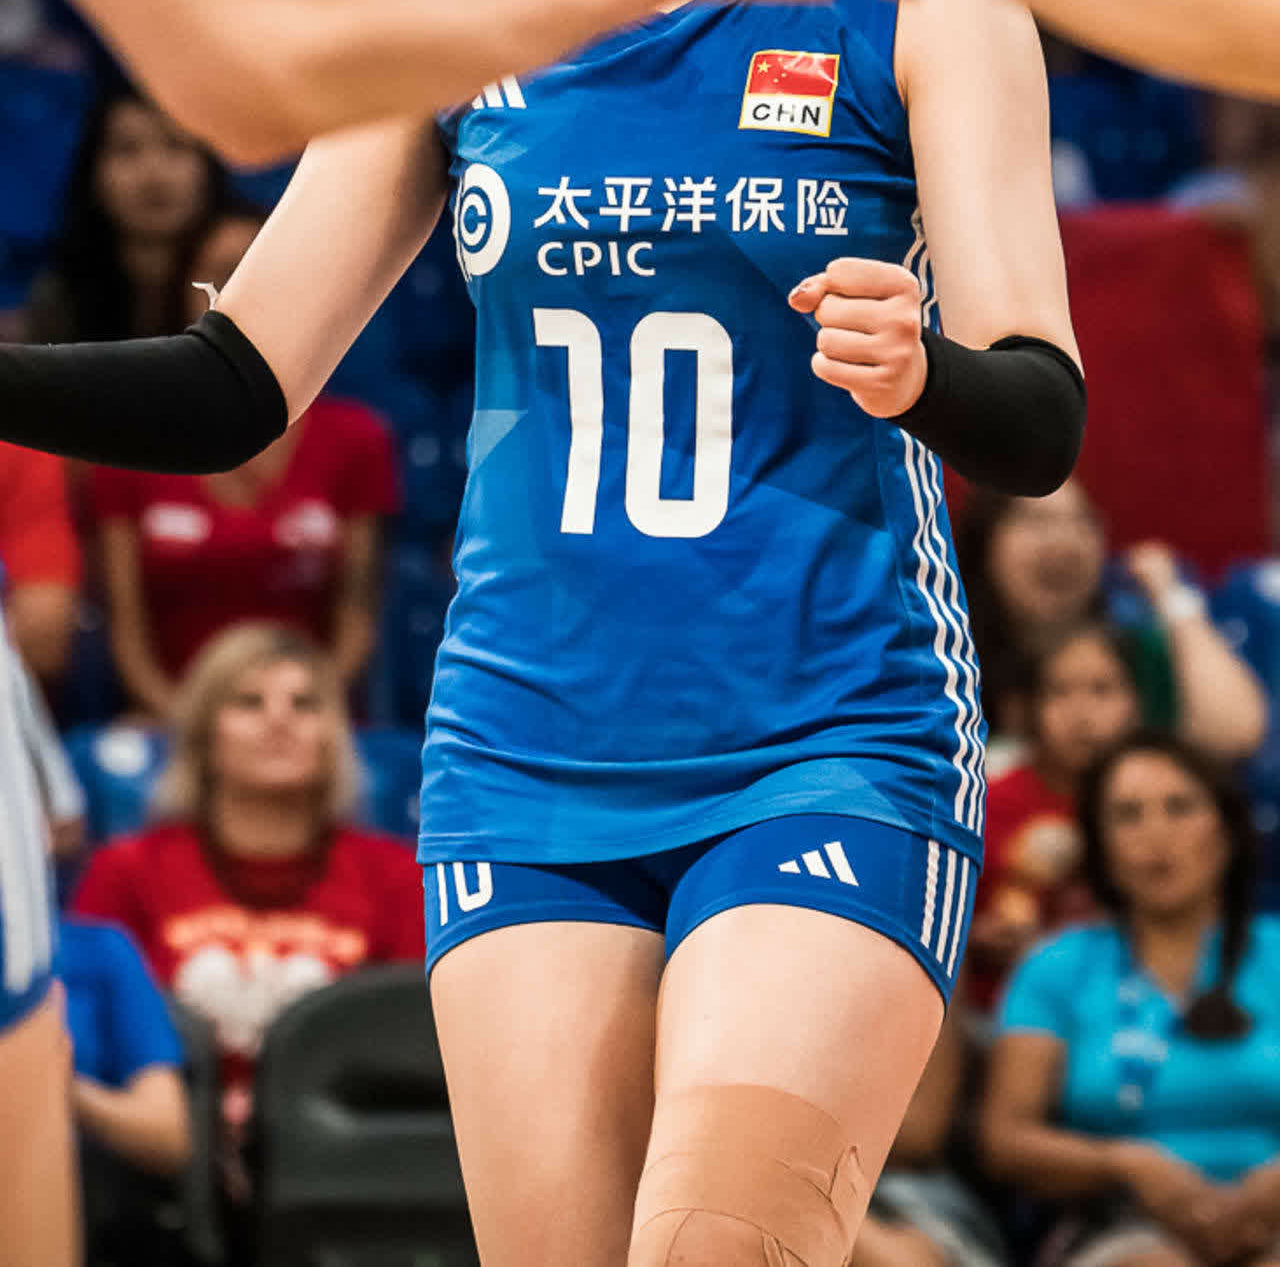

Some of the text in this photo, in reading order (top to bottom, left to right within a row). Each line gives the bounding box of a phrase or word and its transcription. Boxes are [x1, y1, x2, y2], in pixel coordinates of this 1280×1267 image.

[752, 102, 821, 126] CHN
[533, 175, 849, 236] 太平洋保险
[537, 241, 656, 276] CPIC
[532, 307, 734, 538] 10
